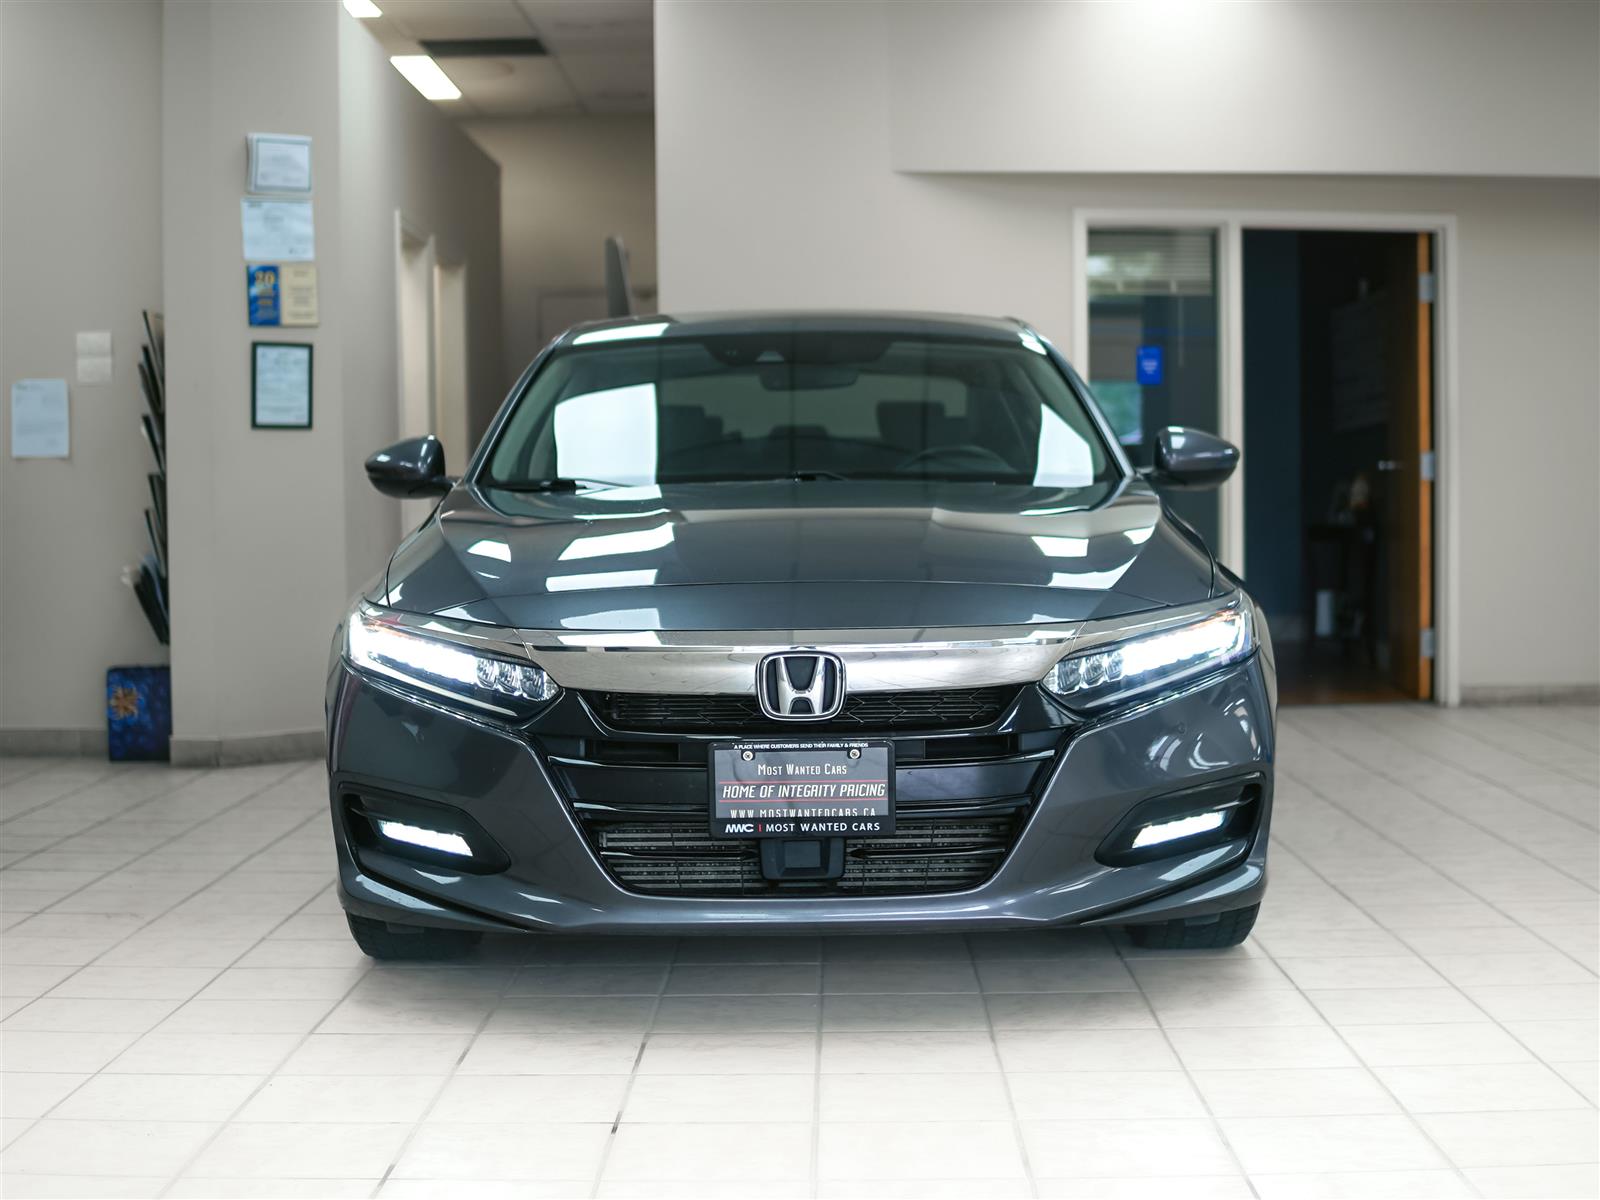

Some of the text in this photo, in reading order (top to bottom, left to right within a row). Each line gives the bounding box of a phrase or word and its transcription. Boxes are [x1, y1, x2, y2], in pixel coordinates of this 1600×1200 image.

[722, 783, 886, 798] HOME OF INTEGRITY PRICING
[765, 823, 795, 832] MOST
[800, 822, 847, 832] WANTED
[852, 822, 880, 831] CARS
